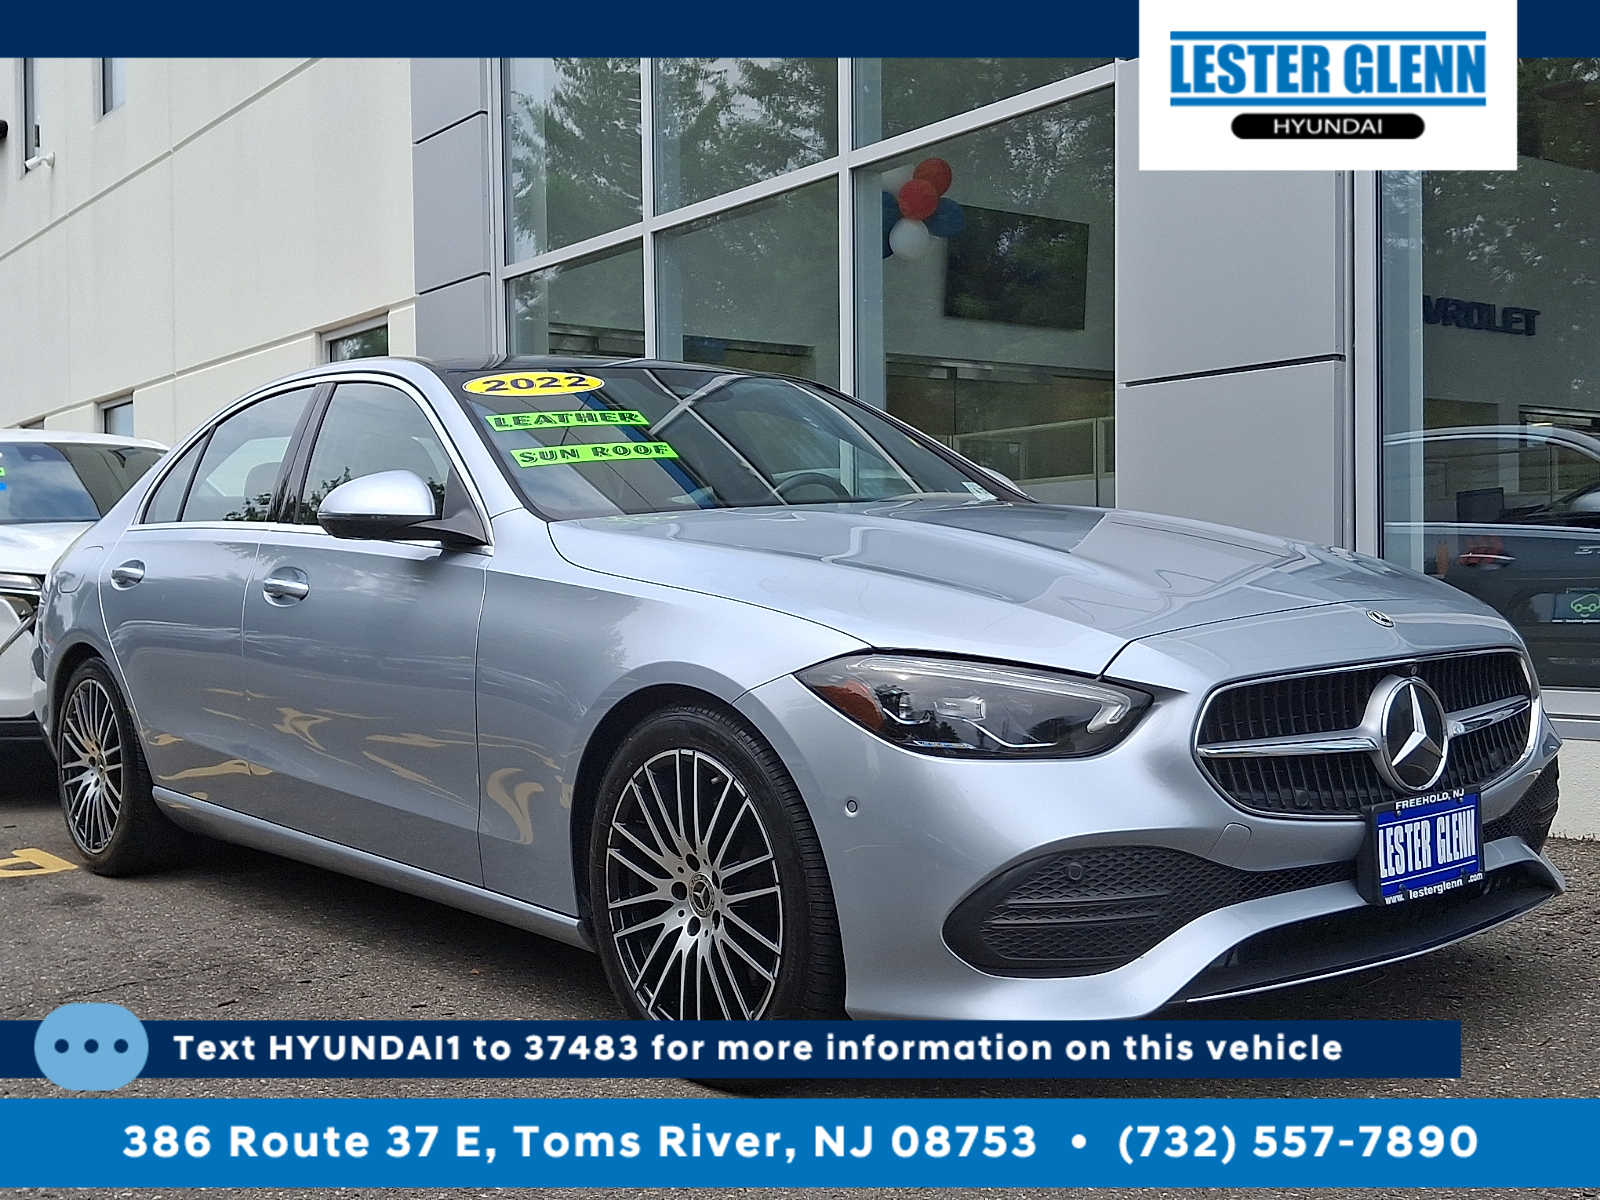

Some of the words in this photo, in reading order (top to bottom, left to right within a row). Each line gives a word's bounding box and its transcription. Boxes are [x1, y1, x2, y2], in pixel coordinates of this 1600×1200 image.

[482, 376, 590, 392] 2022
[494, 411, 641, 428] LEATHER
[520, 448, 580, 463] SUN
[591, 441, 669, 457] ROOF
[1395, 791, 1452, 810] FREEHOLD,
[1453, 788, 1465, 799] NJ
[1378, 820, 1432, 879] LESTER
[1436, 809, 1476, 865] GLENN
[1409, 878, 1463, 900] lesterglenn
